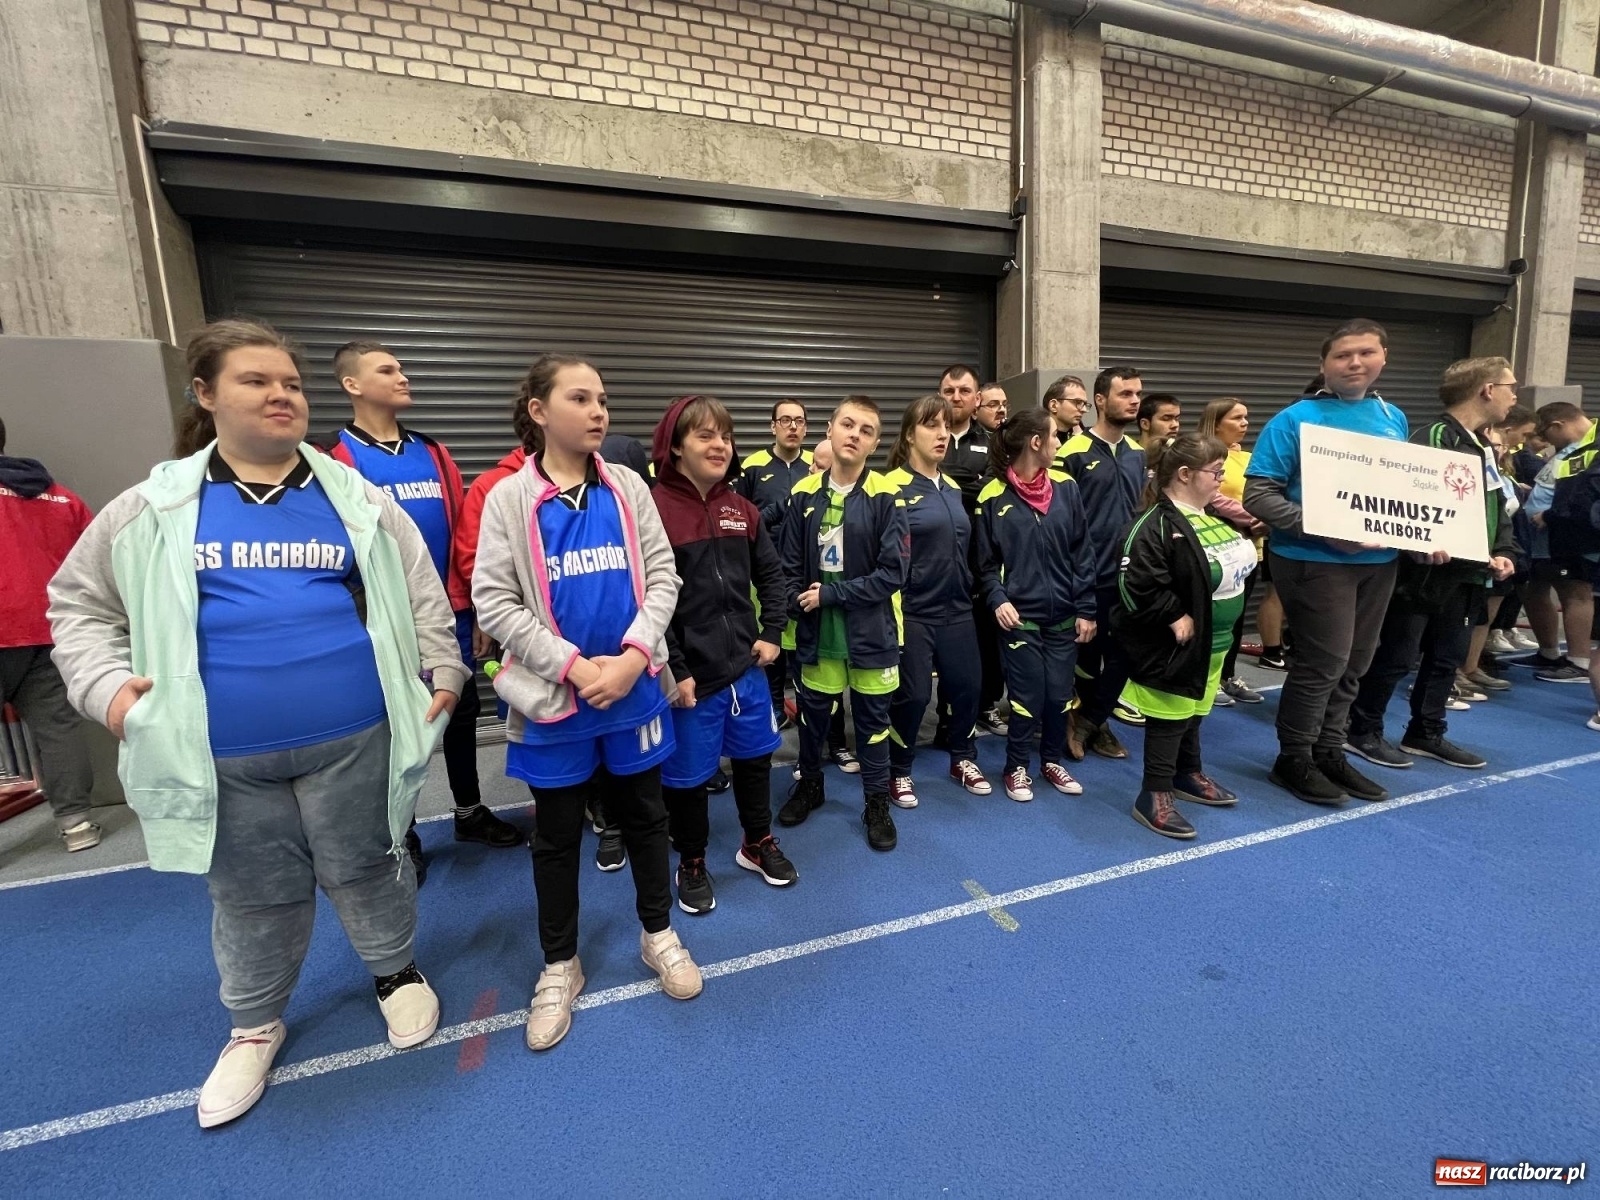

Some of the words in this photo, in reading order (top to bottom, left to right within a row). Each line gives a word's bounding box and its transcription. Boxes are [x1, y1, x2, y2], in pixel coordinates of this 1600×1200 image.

[1309, 444, 1373, 466] Olimpiady
[1378, 457, 1438, 477] Specjalne
[377, 484, 395, 500] S
[395, 478, 443, 500] RACIBÓR
[1412, 477, 1440, 492] Śląskie
[1364, 517, 1432, 542] RACIBÓRZ
[232, 538, 346, 571] RACIBÓRZ
[563, 541, 627, 577] RACIBÓR
